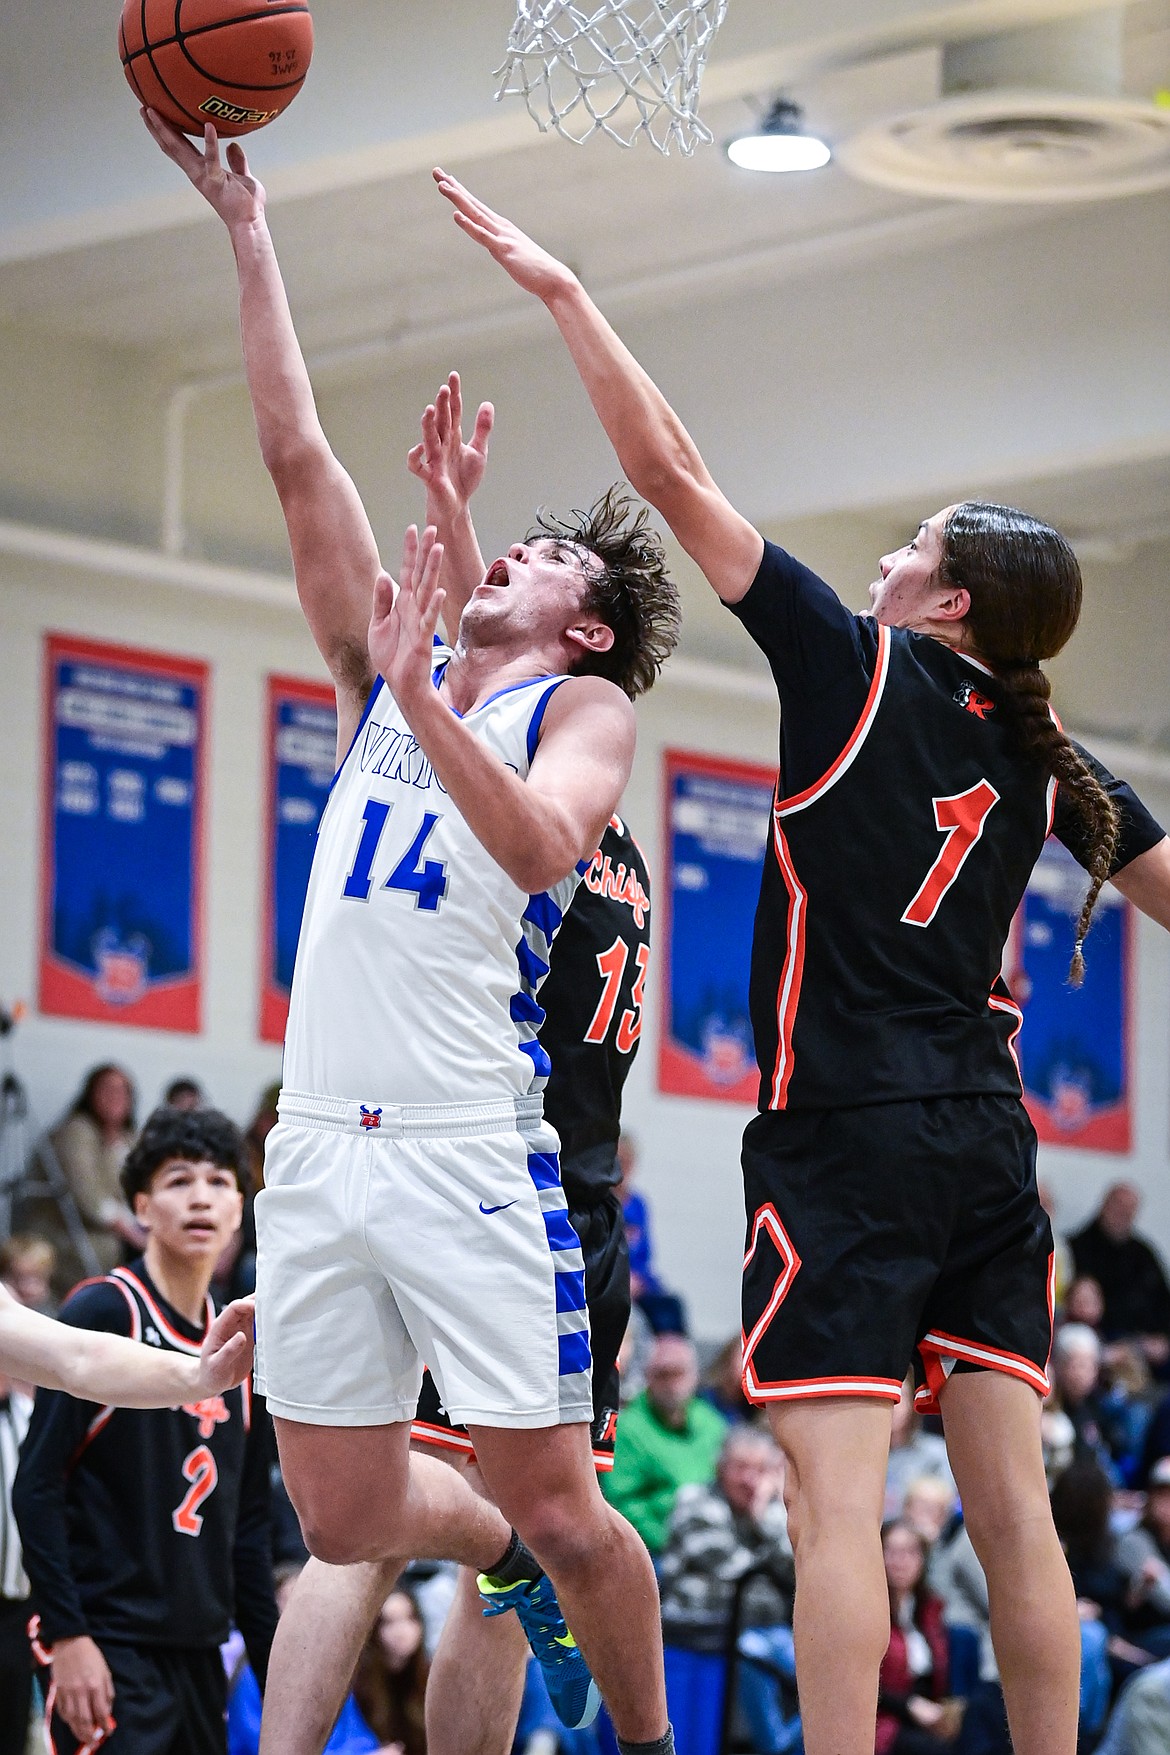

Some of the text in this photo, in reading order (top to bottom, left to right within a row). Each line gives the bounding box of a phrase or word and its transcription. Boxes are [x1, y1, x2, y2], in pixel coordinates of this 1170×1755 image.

[340, 795, 450, 914] 14
[900, 778, 1001, 928] 1
[172, 1444, 219, 1538] 2
